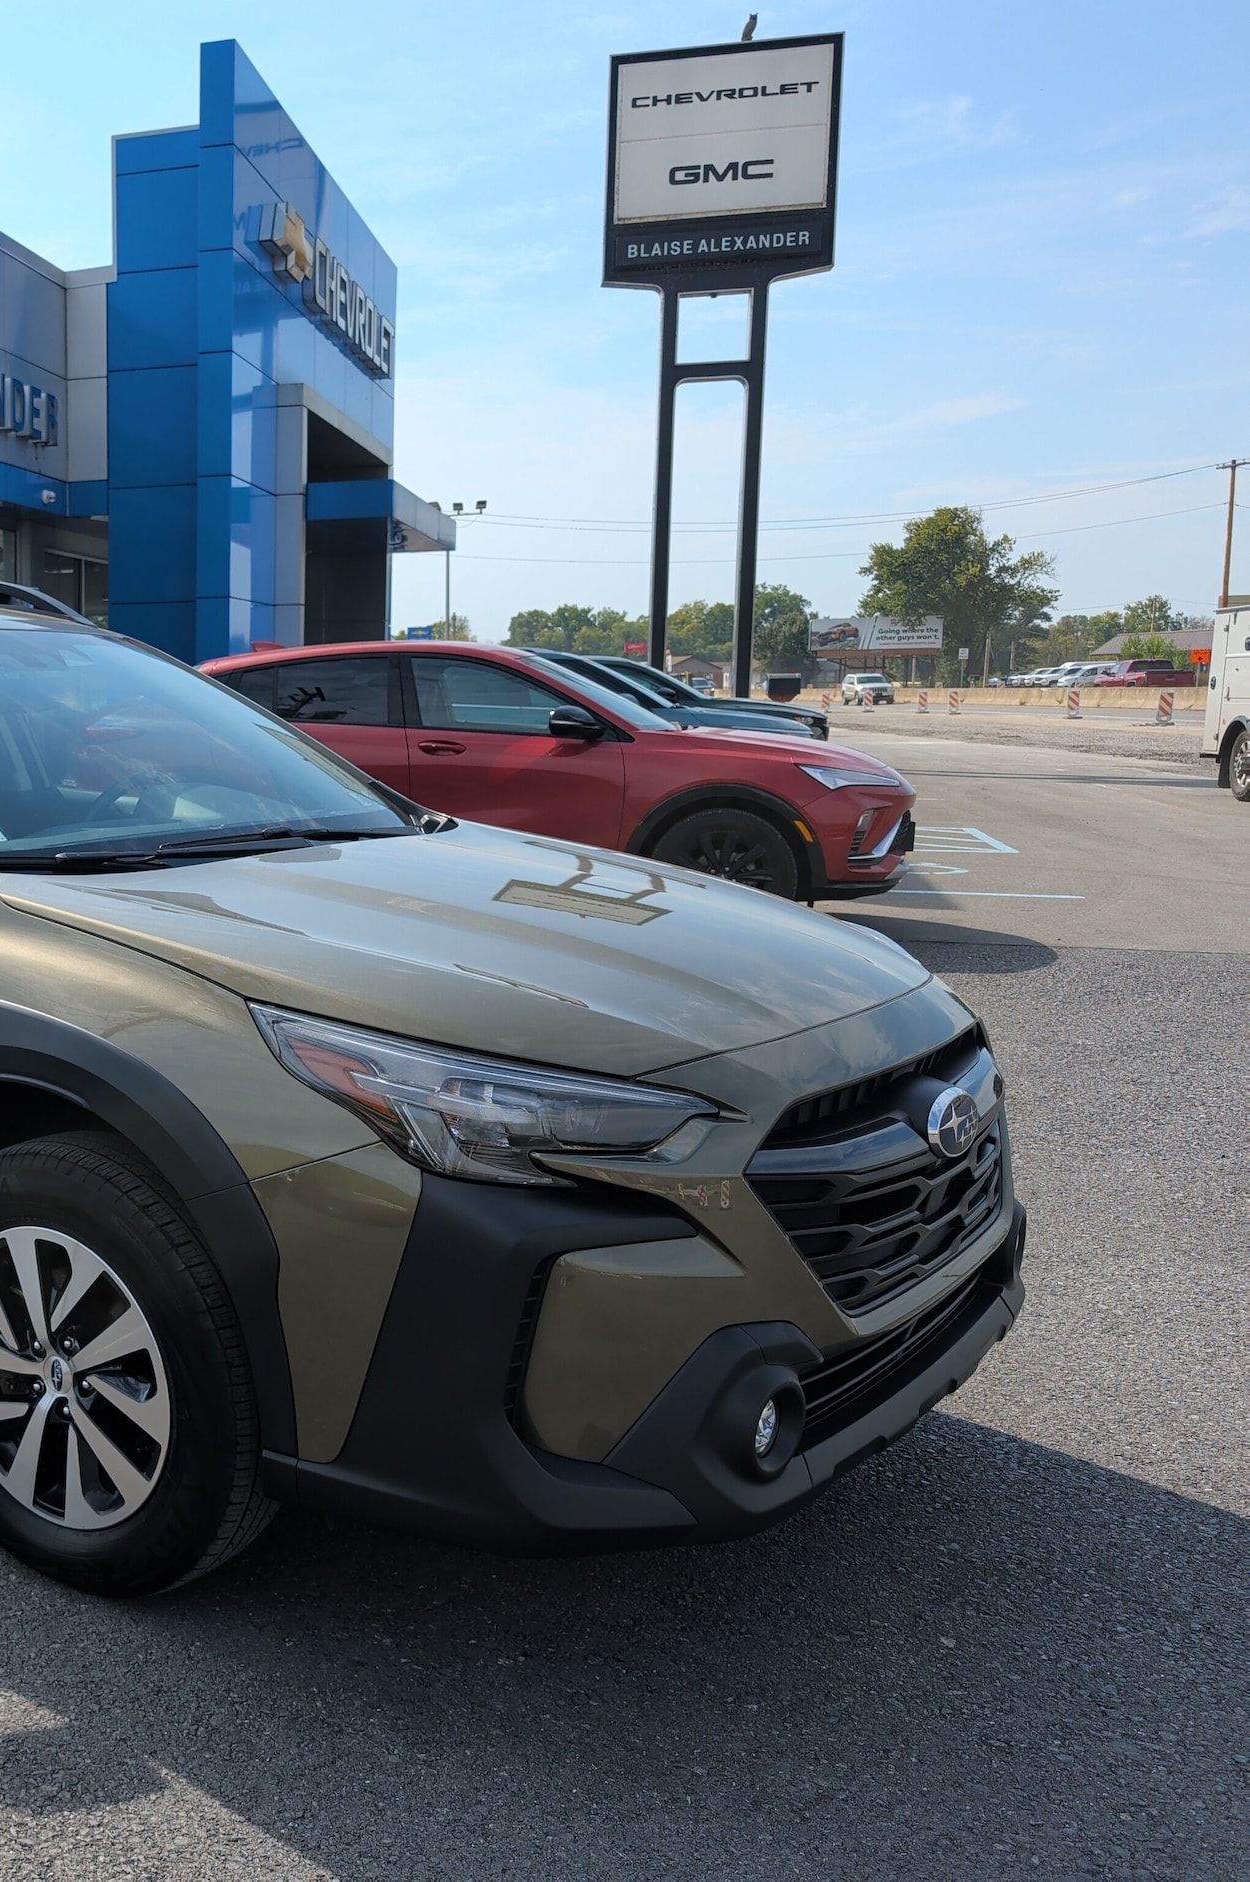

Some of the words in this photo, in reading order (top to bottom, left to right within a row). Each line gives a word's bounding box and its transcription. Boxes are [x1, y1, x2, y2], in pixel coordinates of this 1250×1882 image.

[631, 81, 820, 109] CHEVROLET
[669, 158, 775, 186] GMC
[627, 239, 693, 259] BLAISE
[697, 231, 811, 253] ALEXANDER
[313, 236, 396, 380] CHEVROLET
[878, 627, 900, 635] Going
